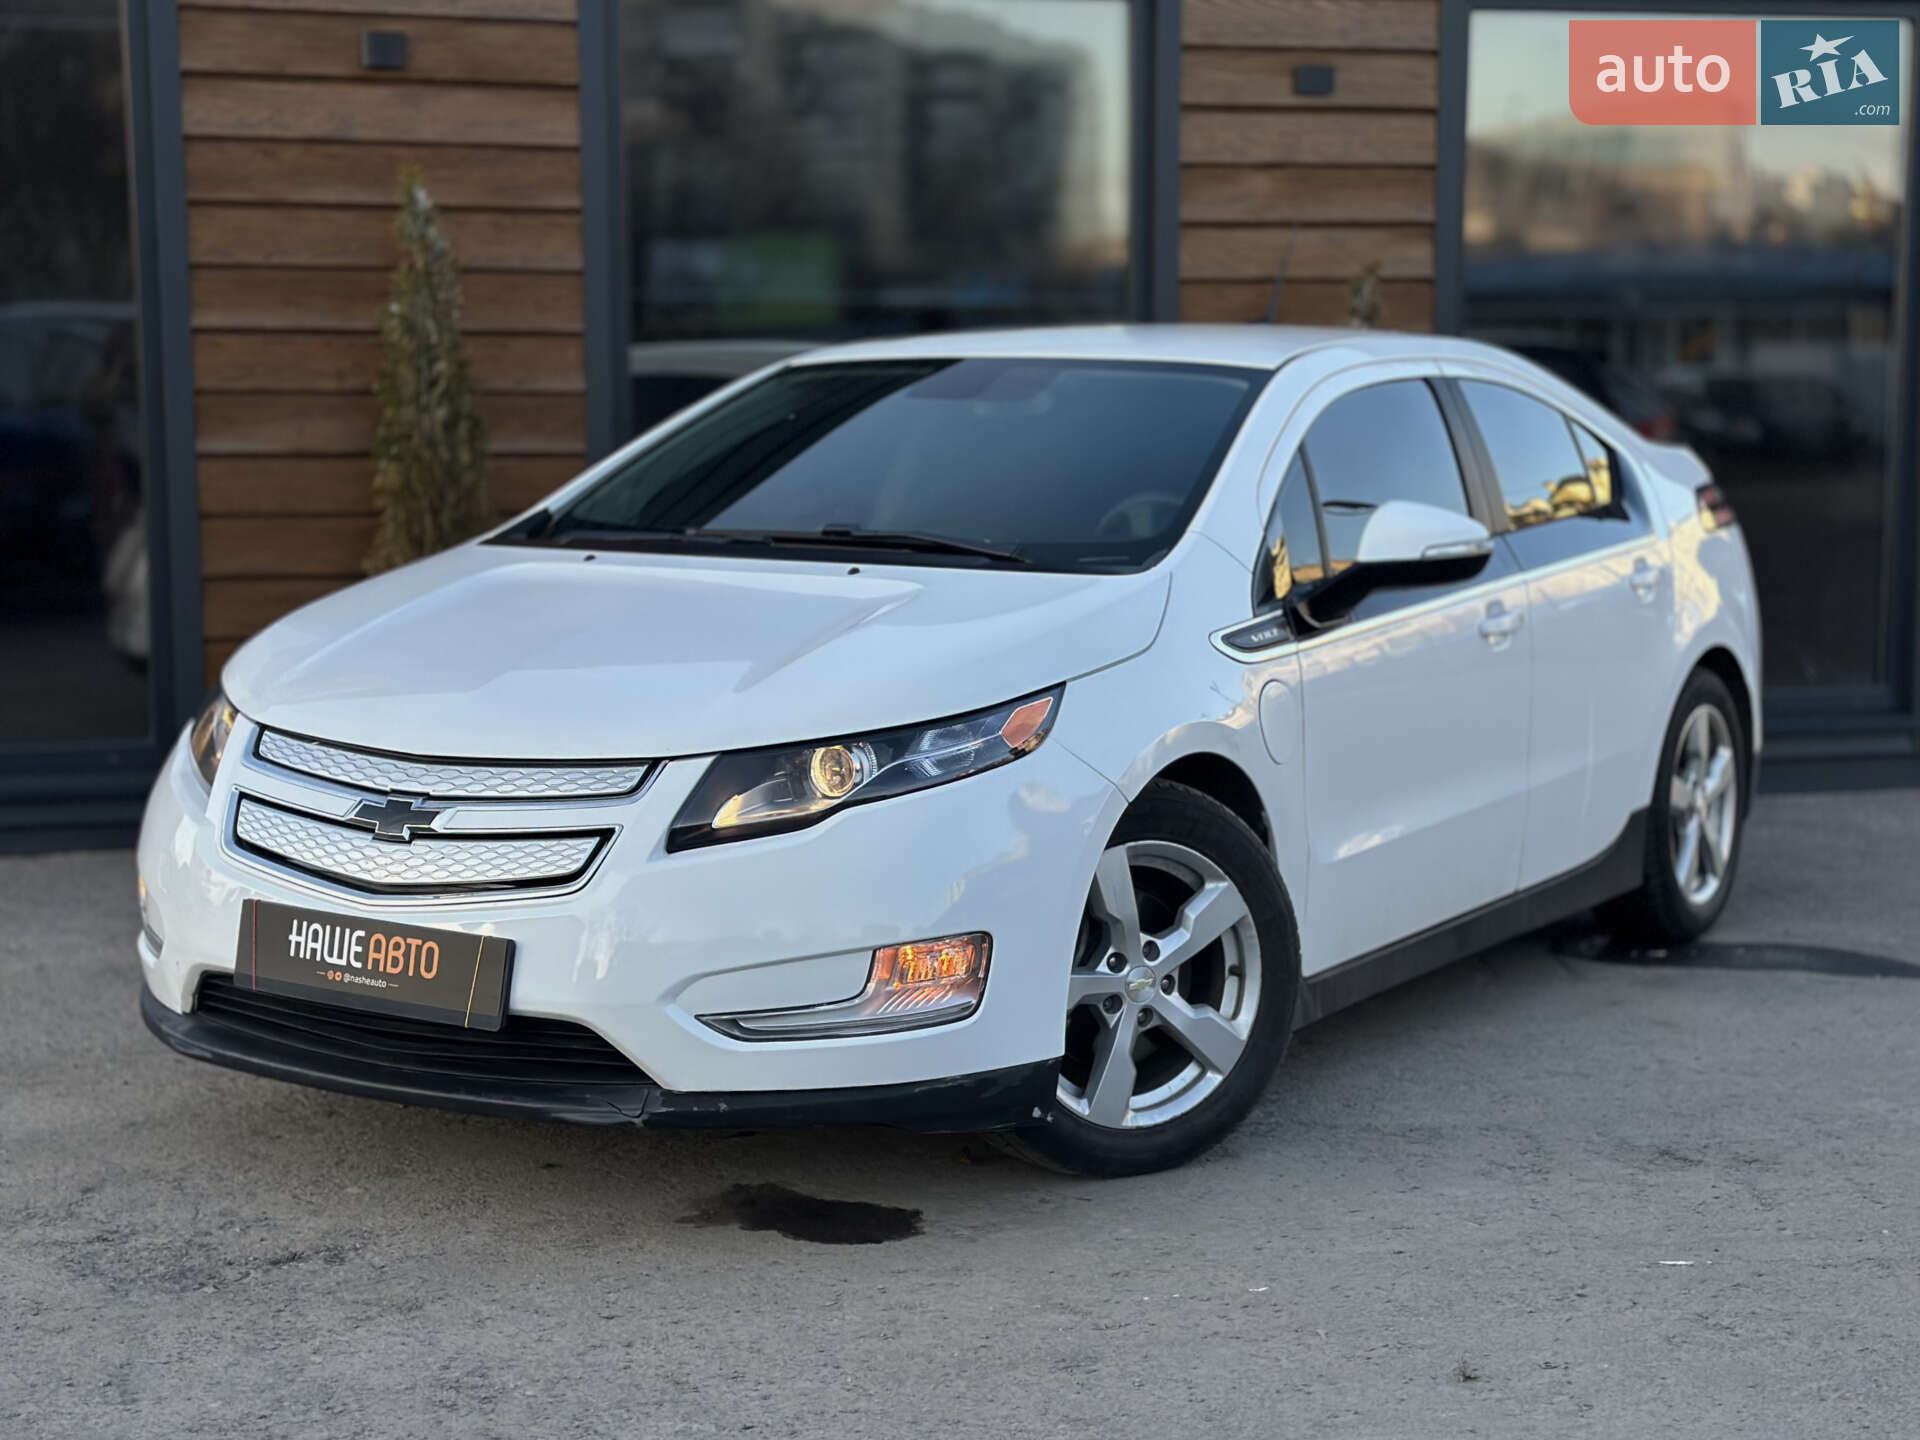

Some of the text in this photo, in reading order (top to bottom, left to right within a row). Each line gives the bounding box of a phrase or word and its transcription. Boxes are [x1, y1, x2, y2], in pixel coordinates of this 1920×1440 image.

[288, 918, 440, 980] НАШЕ АВТО
[343, 972, 387, 988] @nasheauto
